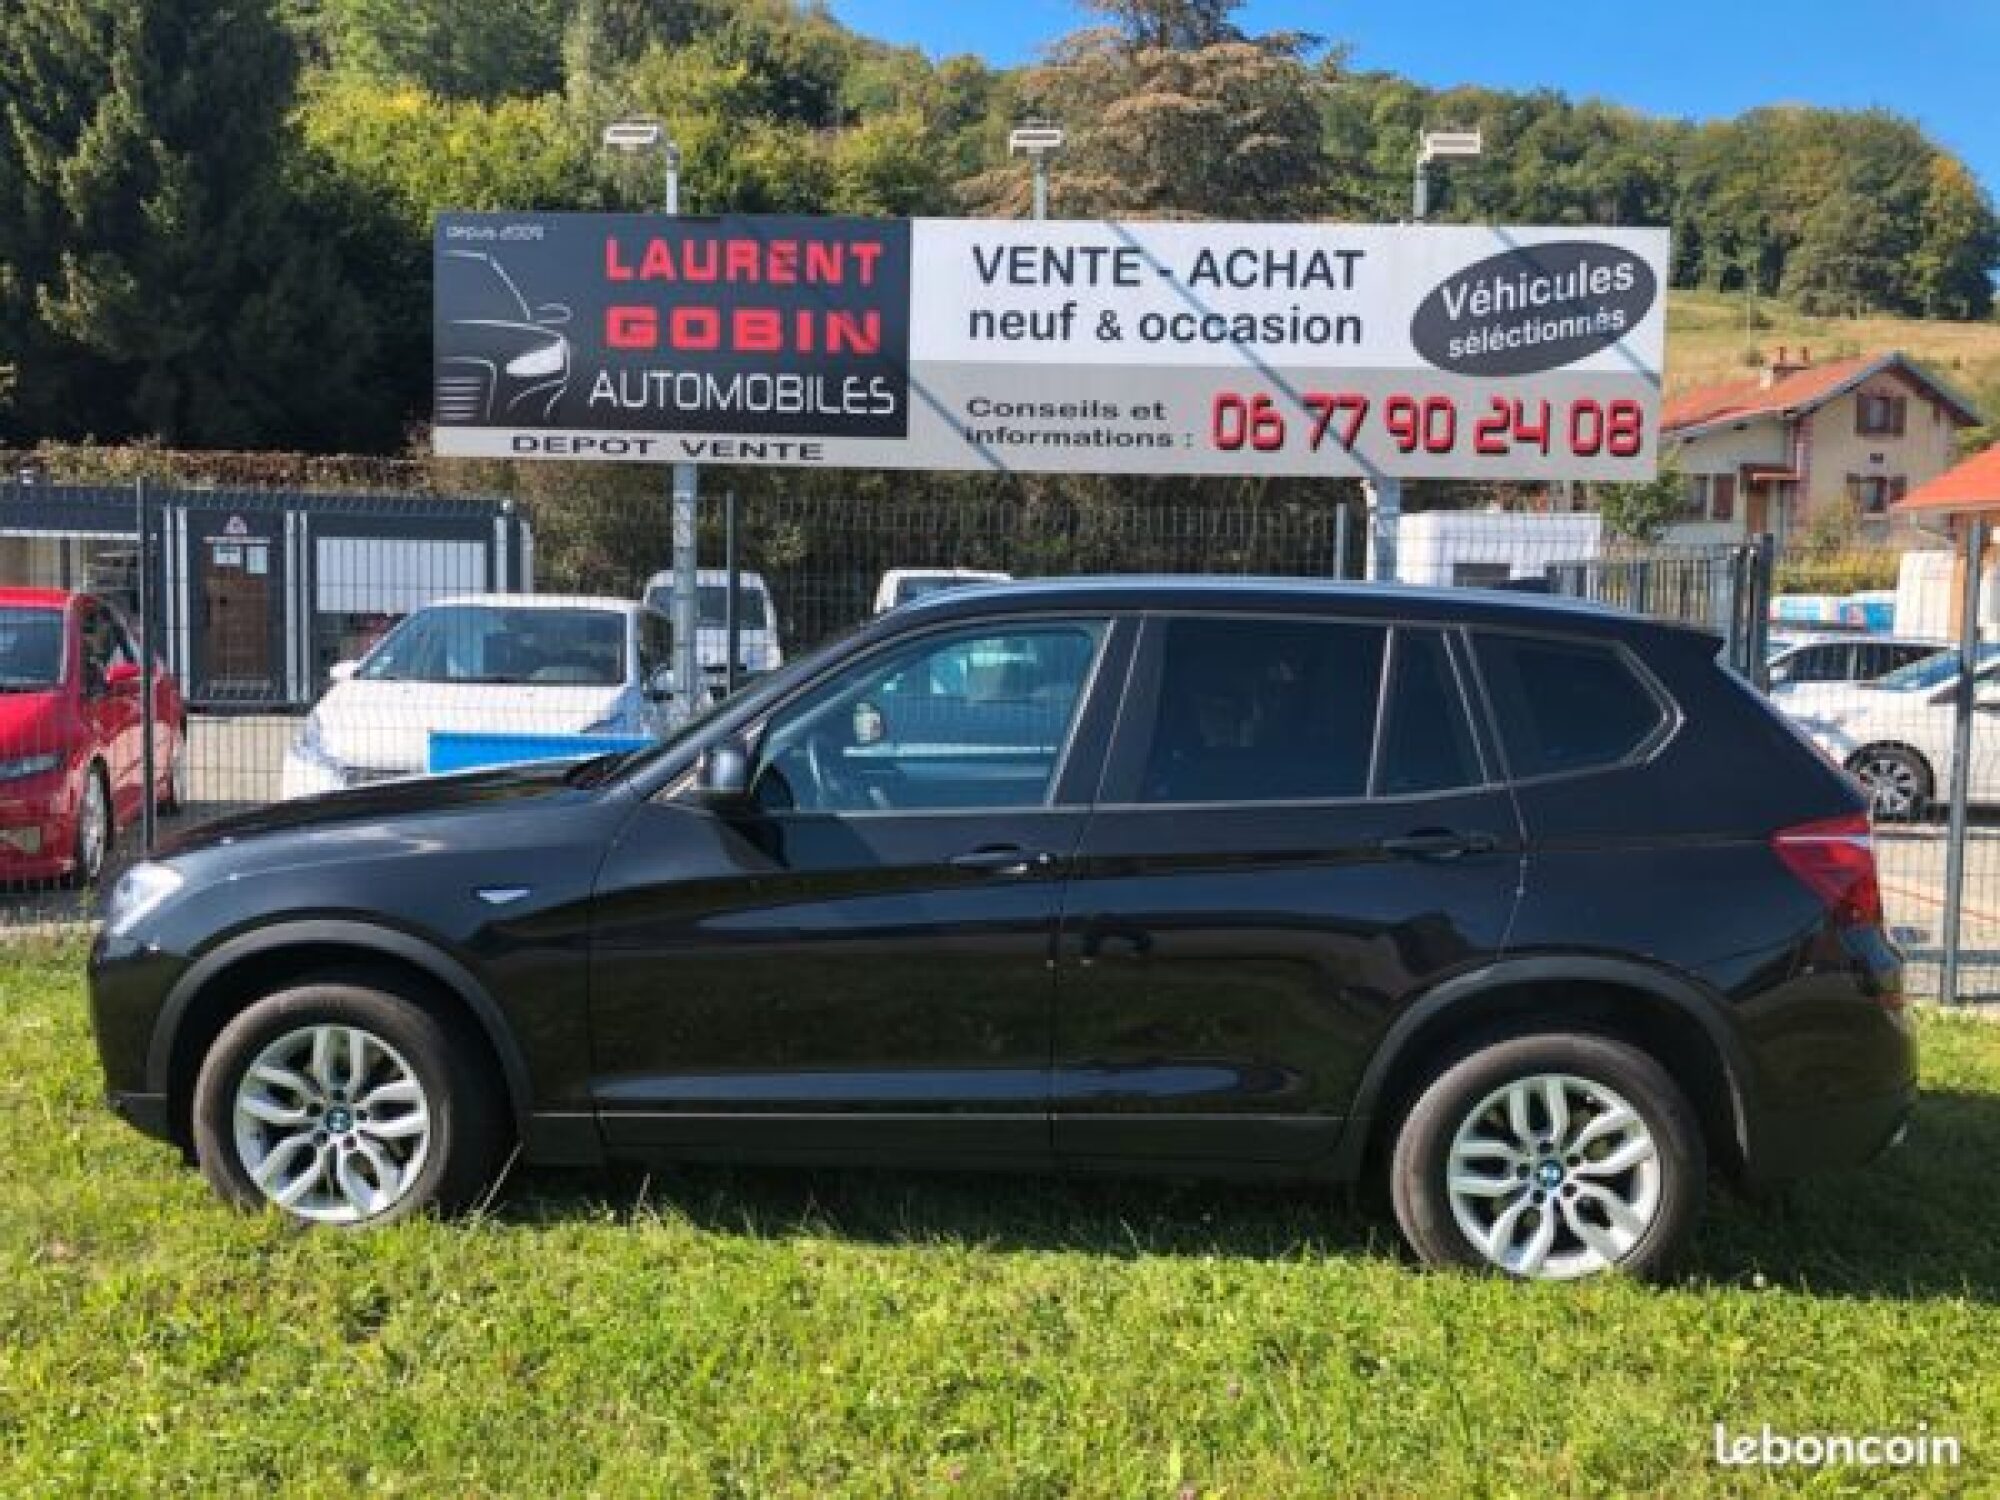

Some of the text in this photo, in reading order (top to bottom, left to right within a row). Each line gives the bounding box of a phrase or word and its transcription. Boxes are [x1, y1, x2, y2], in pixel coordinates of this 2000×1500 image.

[605, 236, 883, 285] LAURENT
[973, 246, 1141, 286] VENTE
[1188, 248, 1364, 290] ACHAT
[1441, 260, 1635, 320] Véhicules
[606, 305, 881, 353] GOBIN
[968, 301, 1363, 345] neuf & occasion
[589, 370, 895, 415] AUTOMOBILES
[966, 398, 1167, 420] Conseils et
[1212, 392, 1643, 458] 06 77 90 24 08
[512, 435, 824, 462] DEPOT VENTE
